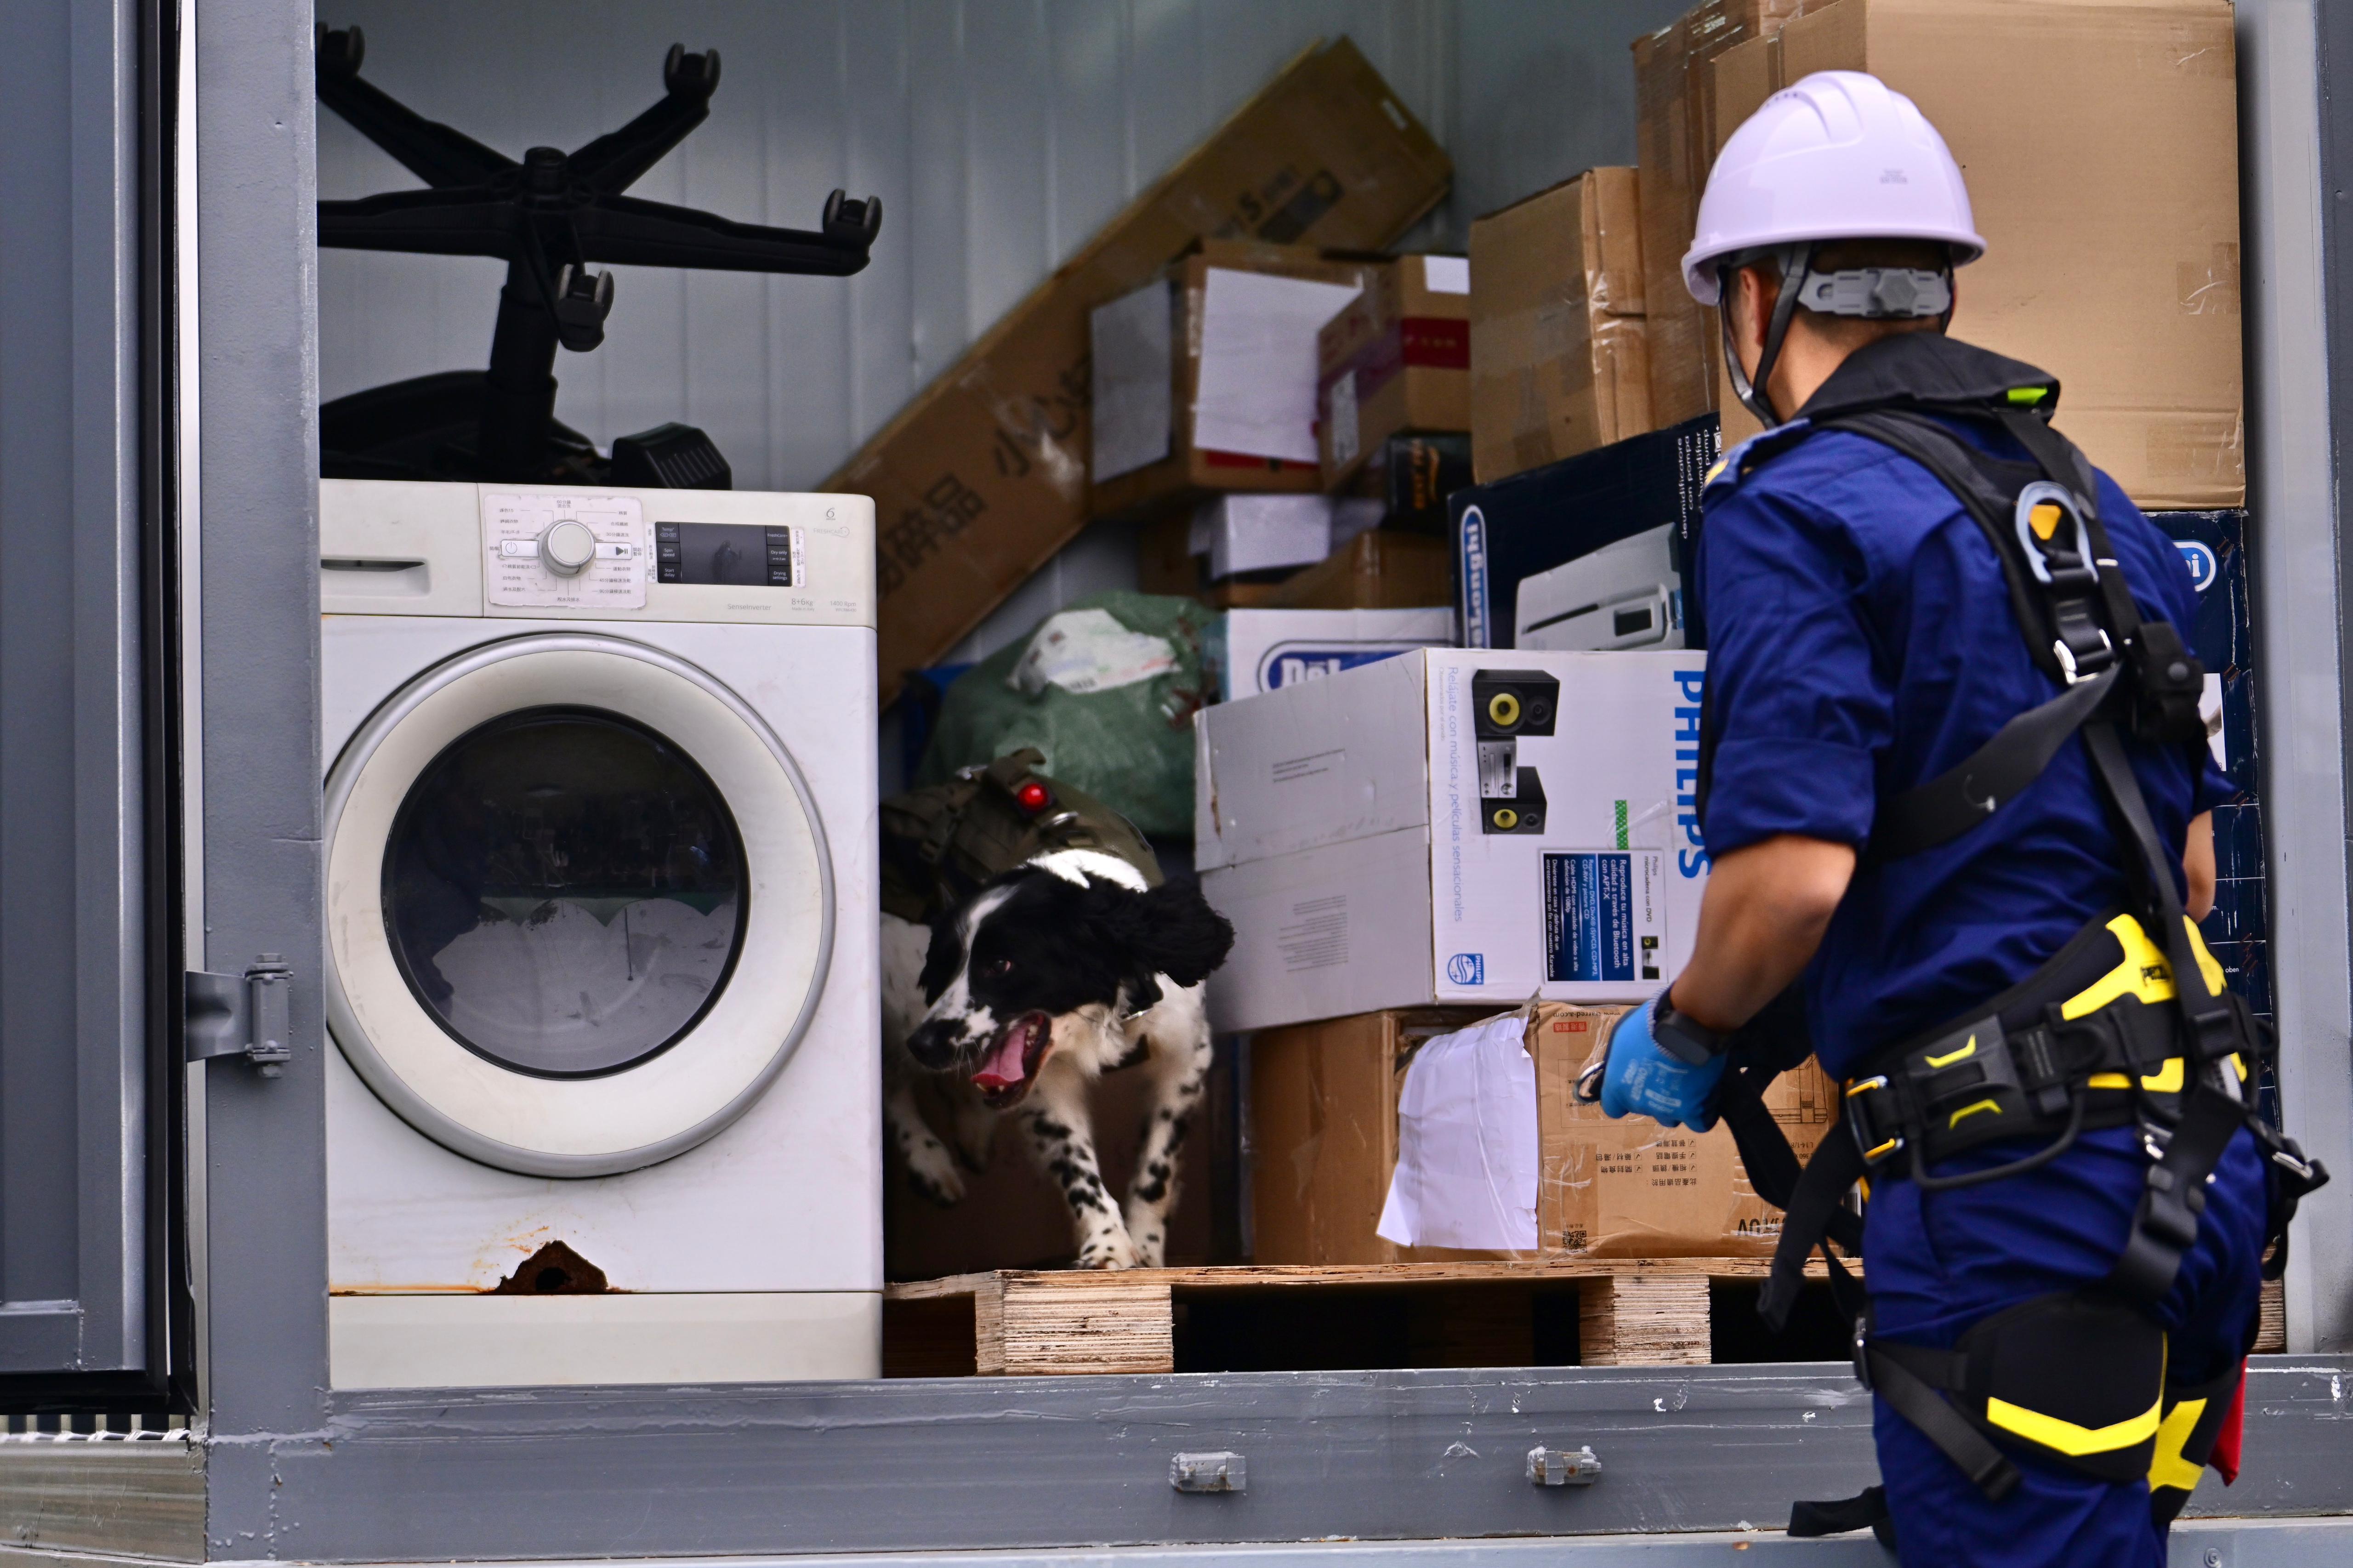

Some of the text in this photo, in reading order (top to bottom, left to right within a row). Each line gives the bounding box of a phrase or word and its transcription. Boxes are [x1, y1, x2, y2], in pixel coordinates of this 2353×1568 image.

[1677, 438, 1688, 539] deumidificatore
[1446, 667, 1460, 711] Relájate
[1449, 741, 1460, 779] música
[1673, 670, 1711, 879] PHILIPS
[1449, 794, 1462, 841] películas
[1453, 846, 1464, 922] sensacionales
[1584, 909, 1589, 919] CD
[1613, 919, 1619, 928] de
[1622, 941, 1628, 950] en
